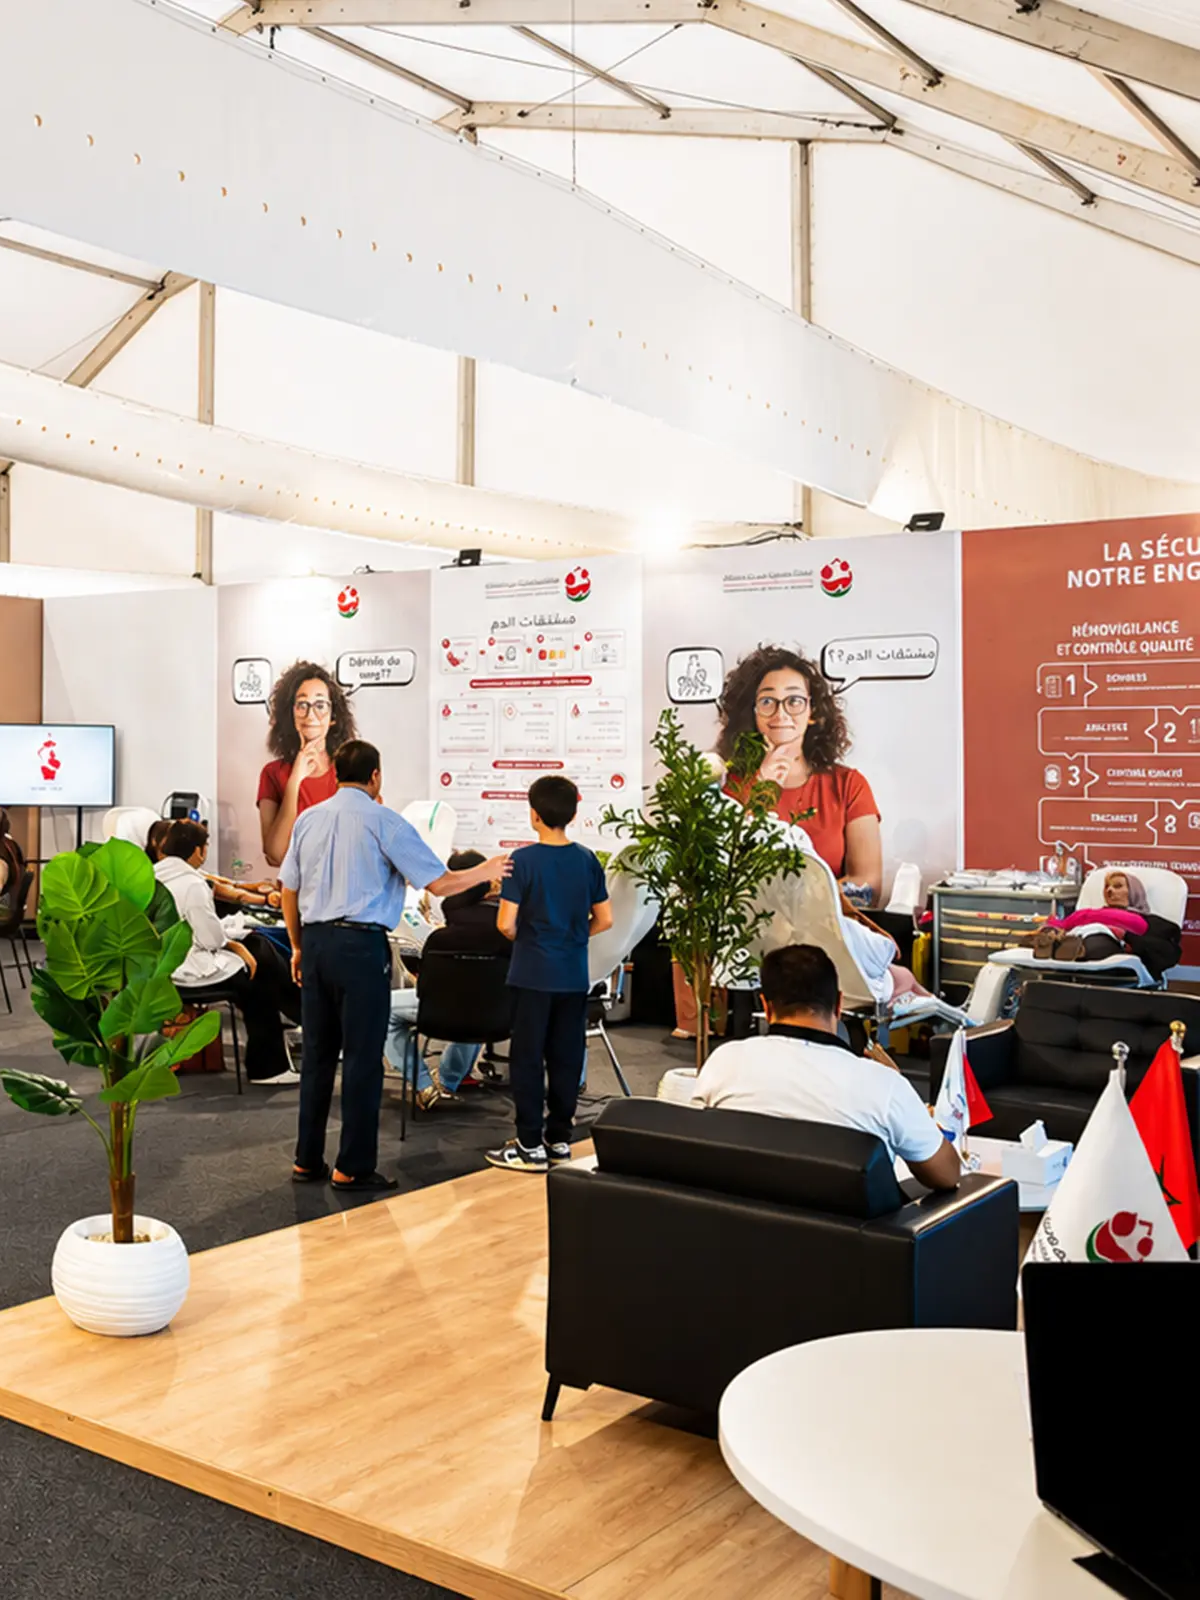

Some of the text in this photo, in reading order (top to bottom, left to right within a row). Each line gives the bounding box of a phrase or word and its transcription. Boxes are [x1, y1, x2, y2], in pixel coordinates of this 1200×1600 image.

[1103, 532, 1200, 562] LA SÉCU
[1067, 561, 1200, 589] NOTRE ENG
[1056, 637, 1194, 656] ET CONTRÔLE QUALITÉ
[1065, 674, 1077, 696] 1
[1163, 722, 1177, 744] 2
[1068, 765, 1081, 787] 3
